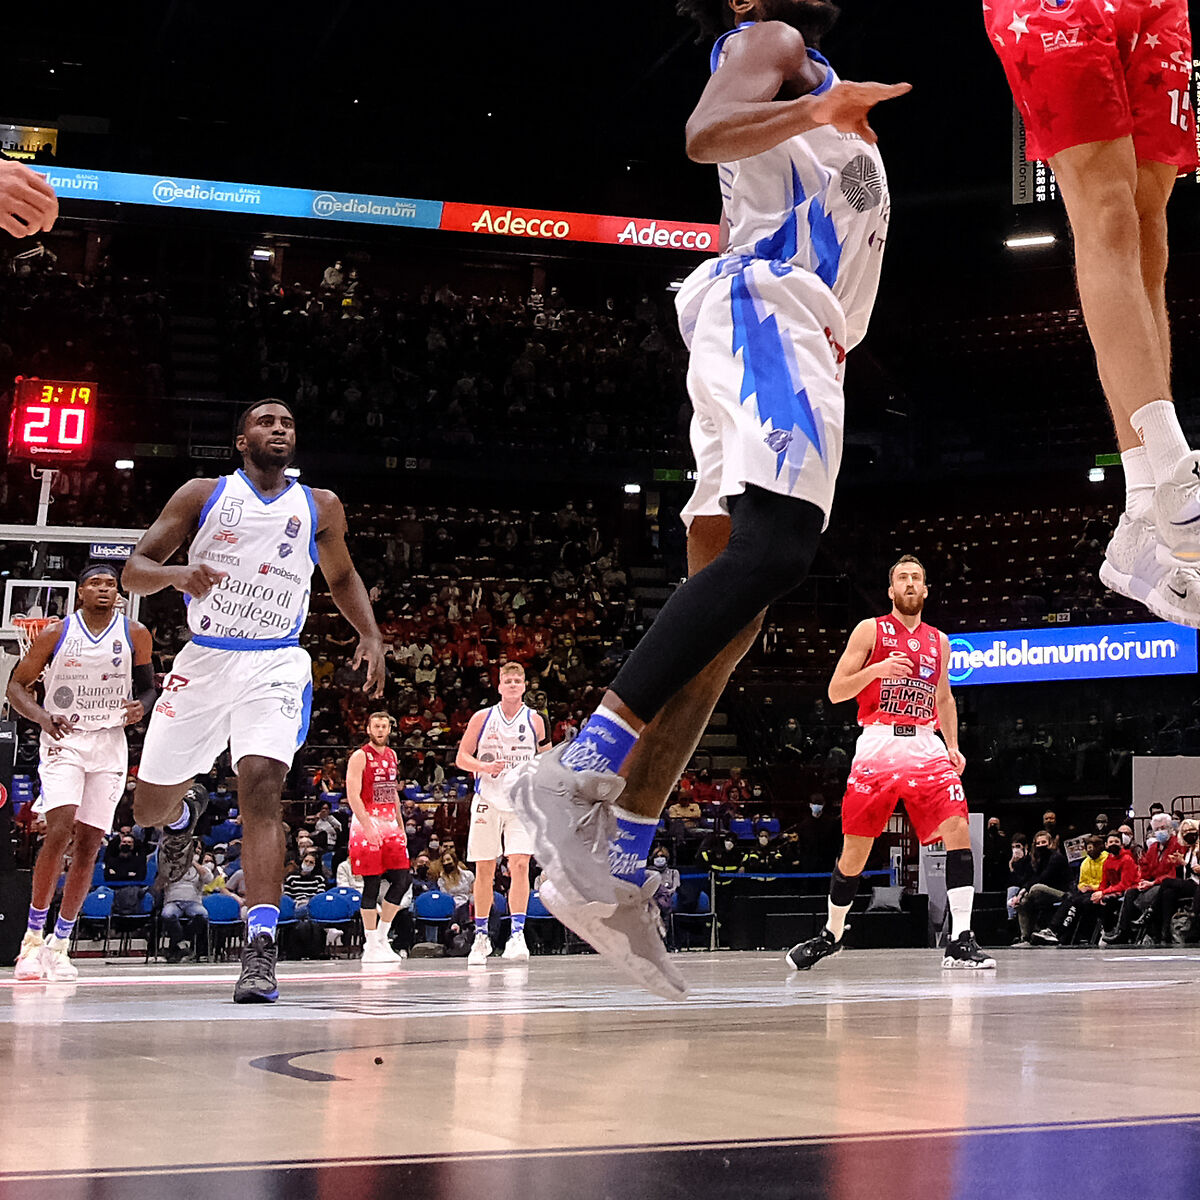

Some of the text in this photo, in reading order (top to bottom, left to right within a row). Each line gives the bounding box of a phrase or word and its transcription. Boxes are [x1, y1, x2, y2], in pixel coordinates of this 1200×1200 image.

[1041, 28, 1080, 49] EA7
[153, 180, 261, 205] mediolanum
[313, 194, 417, 218] mediolanum
[471, 209, 712, 249] Adecco Adecco
[41, 385, 91, 404] 3:19
[23, 406, 86, 444] 20
[219, 496, 244, 528] 5
[218, 573, 293, 609] Banco di
[210, 593, 292, 630] Sardegna
[63, 638, 83, 658] 21
[948, 636, 1176, 670] mediolanumforum
[946, 784, 965, 801] 13
